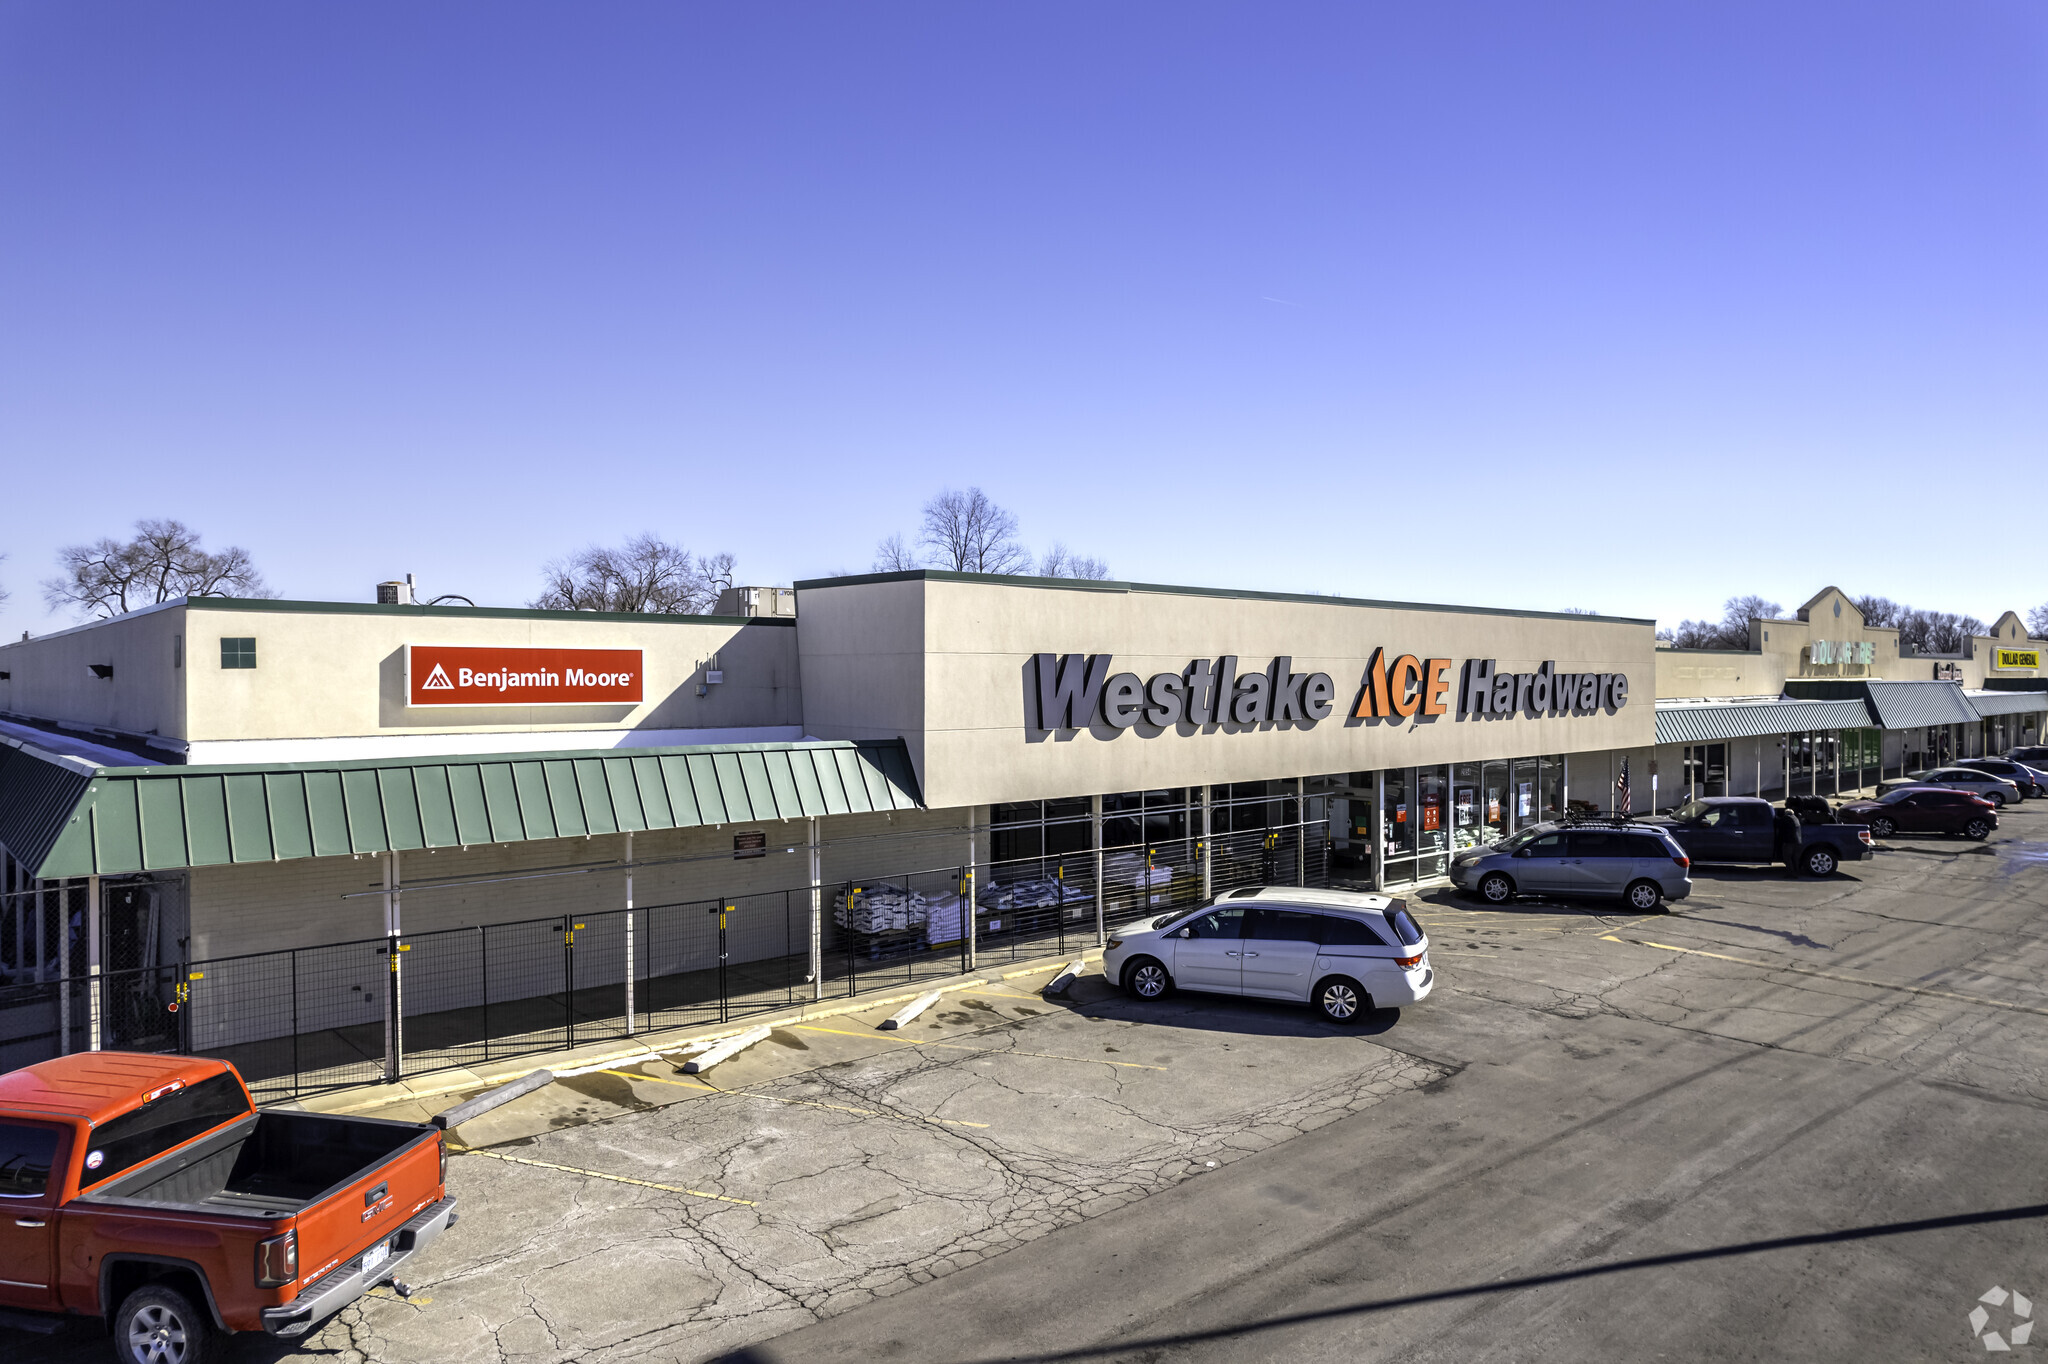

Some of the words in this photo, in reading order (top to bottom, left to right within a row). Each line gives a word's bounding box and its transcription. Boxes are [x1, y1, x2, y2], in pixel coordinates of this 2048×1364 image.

[2001, 652, 2018, 665] DOLLAR
[458, 667, 560, 692] Benjamin
[1034, 653, 1335, 730] Westlake
[1352, 646, 1451, 718] ACE
[1462, 659, 1629, 713] Hardware
[361, 1194, 393, 1223] GMC
